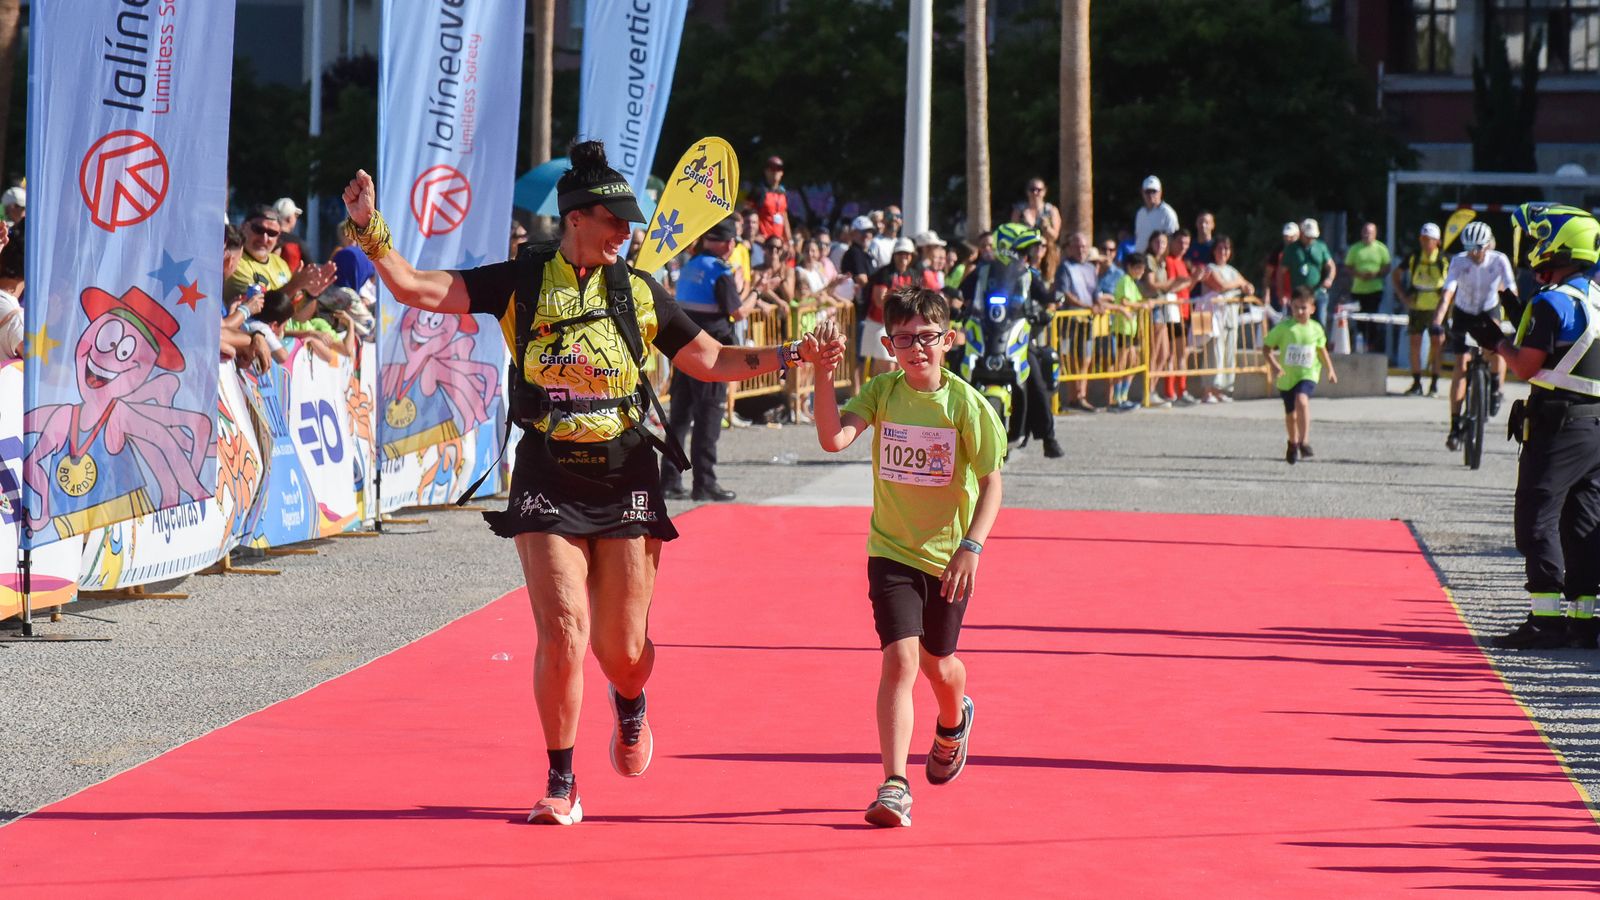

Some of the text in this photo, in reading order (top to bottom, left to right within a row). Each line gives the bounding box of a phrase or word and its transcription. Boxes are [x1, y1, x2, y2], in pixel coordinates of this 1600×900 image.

[152, 22, 174, 114] Limitless
[460, 33, 483, 155] Limitless Safety
[706, 190, 730, 211] Sport
[584, 366, 619, 377] Sport
[884, 427, 894, 437] XXI
[557, 456, 608, 464] HANKER
[884, 443, 927, 469] 1029
[59, 460, 95, 495] BOLARDITO
